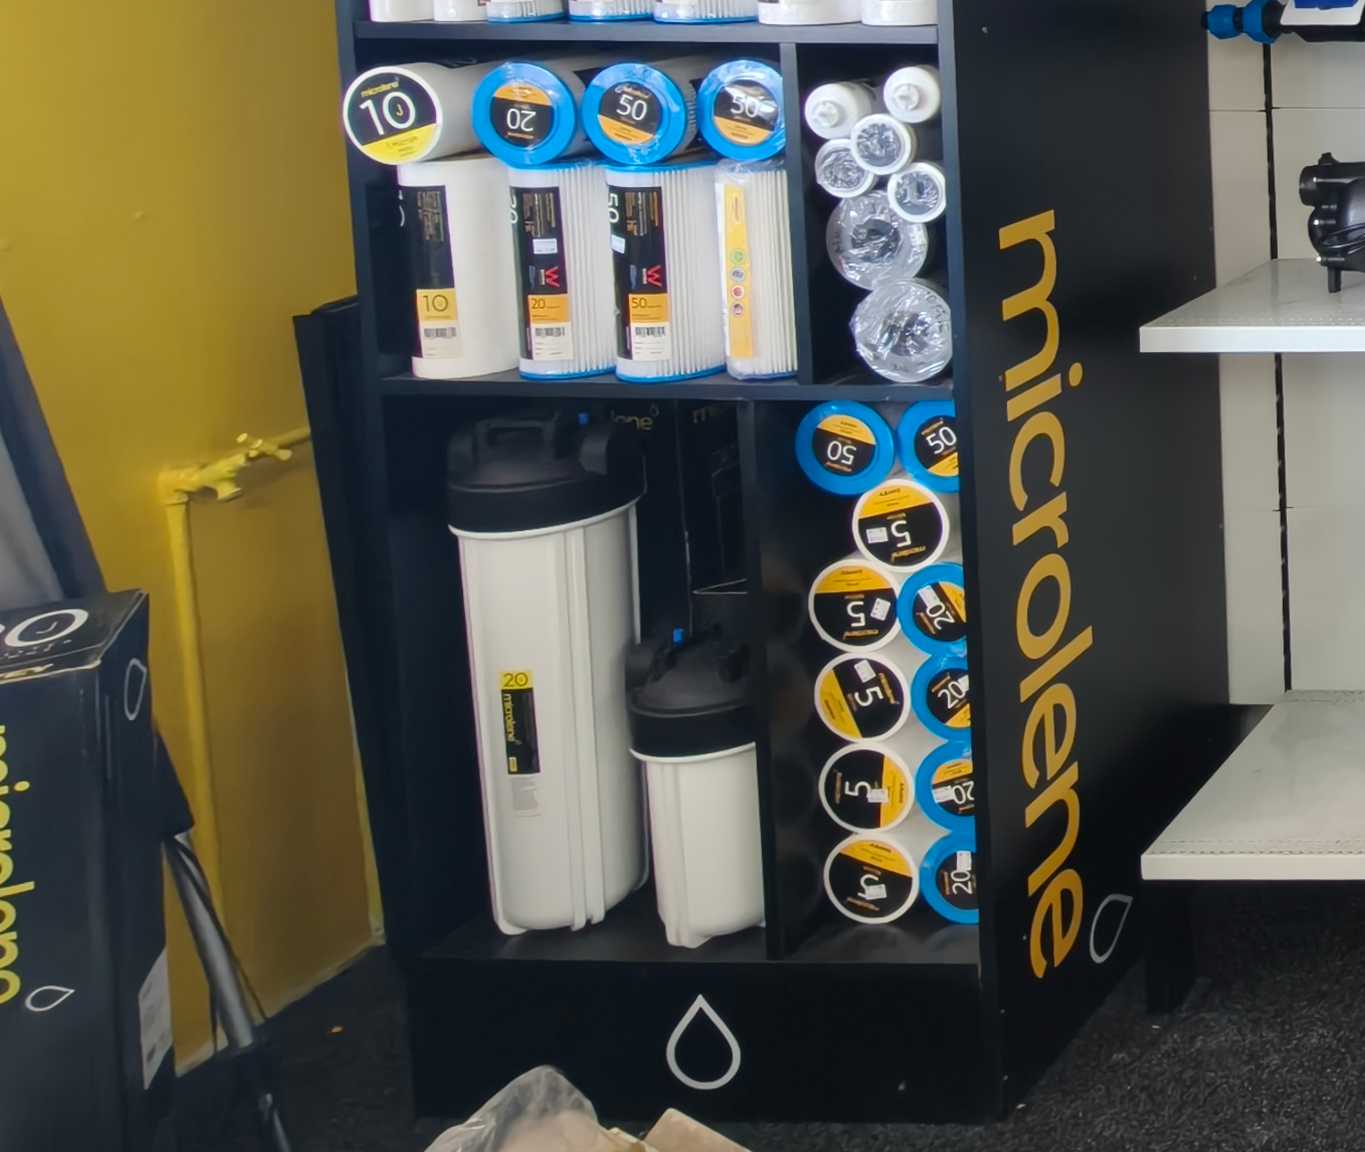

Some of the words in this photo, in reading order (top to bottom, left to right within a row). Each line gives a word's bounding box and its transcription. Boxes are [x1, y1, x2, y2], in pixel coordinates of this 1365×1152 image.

[360, 92, 416, 135] 10
[616, 94, 647, 121] 50
[730, 95, 761, 118] 50
[507, 108, 537, 132] 20
[424, 295, 448, 312] 10
[531, 298, 546, 310] 20
[632, 298, 647, 309] 50
[827, 440, 857, 465] 50
[926, 426, 957, 455] 50
[890, 520, 911, 548] 5
[998, 209, 1093, 979] microlene
[847, 601, 866, 627] 5
[926, 603, 954, 630] 20
[503, 672, 528, 687] 20
[854, 686, 884, 707] 5
[937, 680, 965, 710] 20
[952, 870, 974, 896] 20
